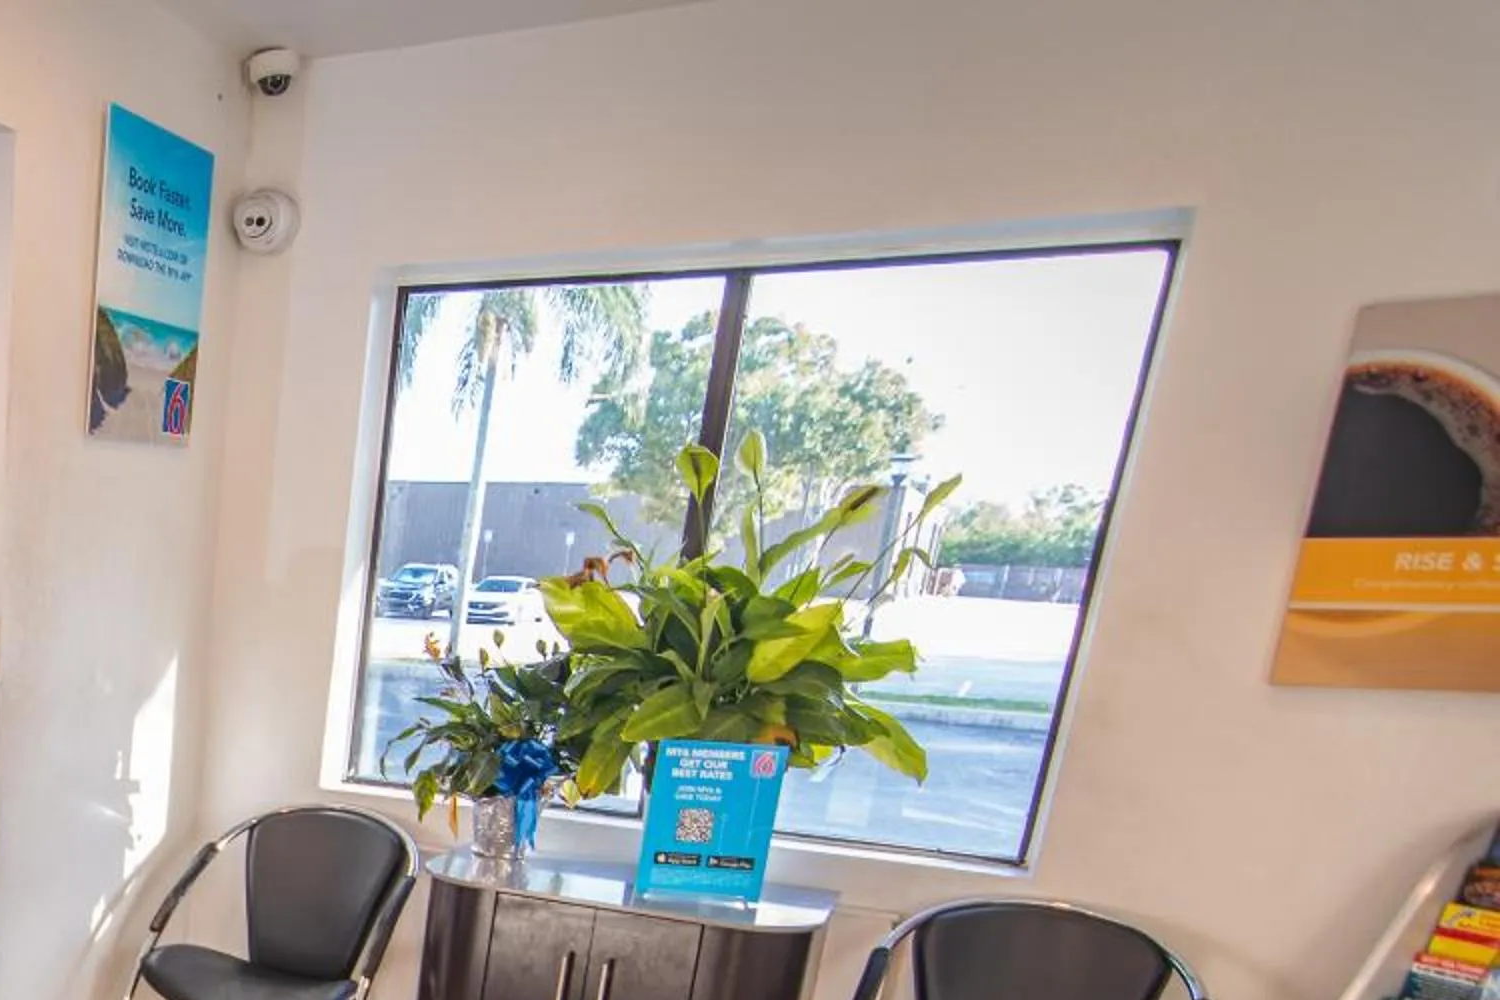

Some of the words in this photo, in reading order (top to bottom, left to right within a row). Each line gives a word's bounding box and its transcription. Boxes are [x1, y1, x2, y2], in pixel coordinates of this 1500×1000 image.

[129, 166, 157, 195] Book
[130, 197, 155, 225] Save
[158, 208, 187, 237] More.
[166, 382, 188, 436] 6
[1395, 551, 1453, 572] RISE
[1462, 551, 1483, 573] &
[679, 758, 702, 769] GET
[703, 759, 729, 770] OUR
[692, 748, 746, 761] MEMBERS
[671, 768, 698, 779] BEST
[699, 769, 733, 781] RATES
